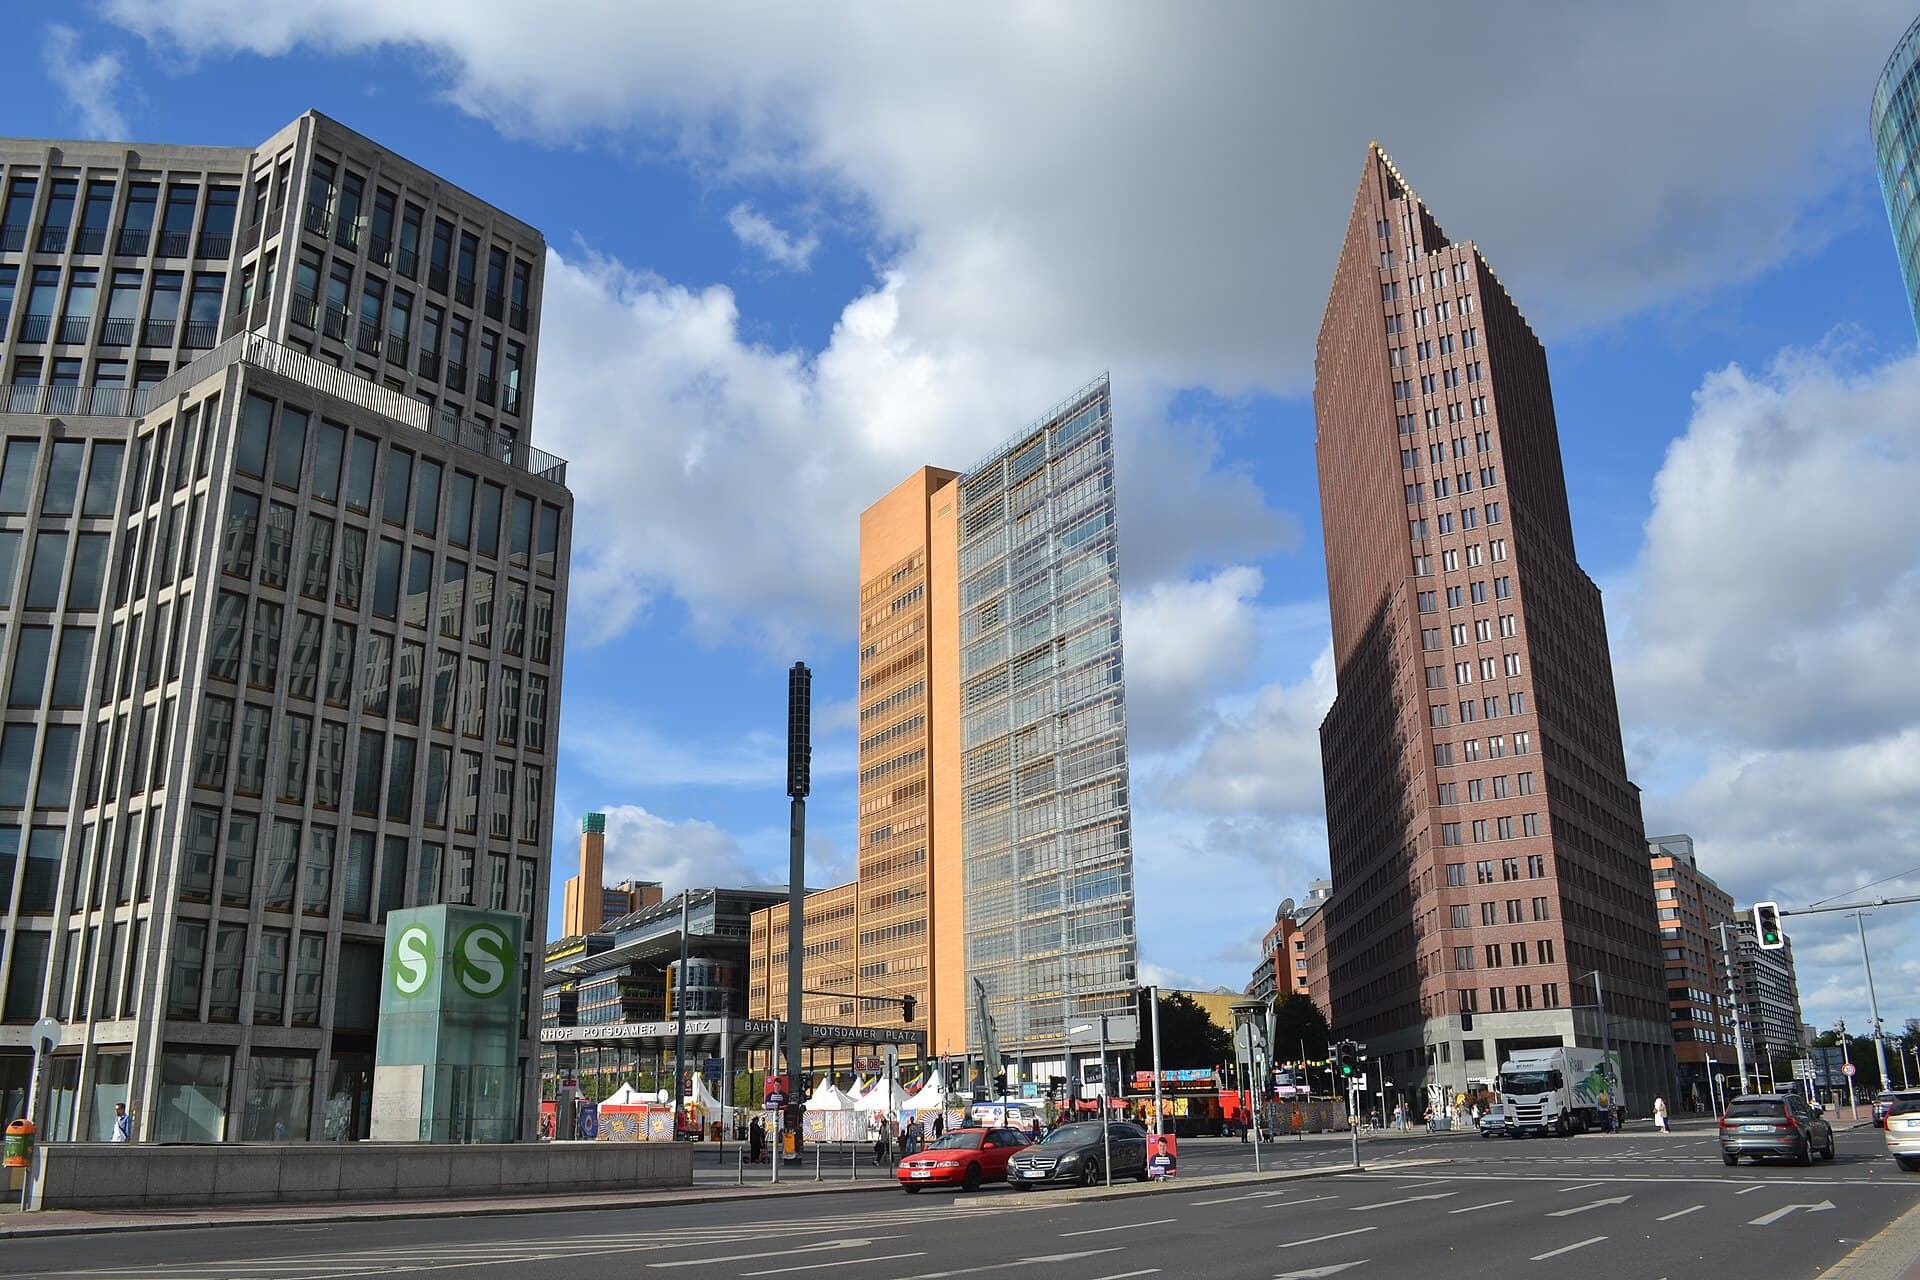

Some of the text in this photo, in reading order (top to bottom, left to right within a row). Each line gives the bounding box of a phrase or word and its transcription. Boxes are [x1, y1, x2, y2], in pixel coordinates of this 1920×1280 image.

[397, 928, 428, 993] S
[463, 928, 504, 994] S
[541, 1028, 573, 1040] NHOF
[583, 1024, 657, 1038] POTSDAMER
[744, 1021, 916, 1041] BAHNH POTSDAMER PLATZ
[856, 1060, 865, 1069] DB
[869, 1060, 878, 1069] DB
